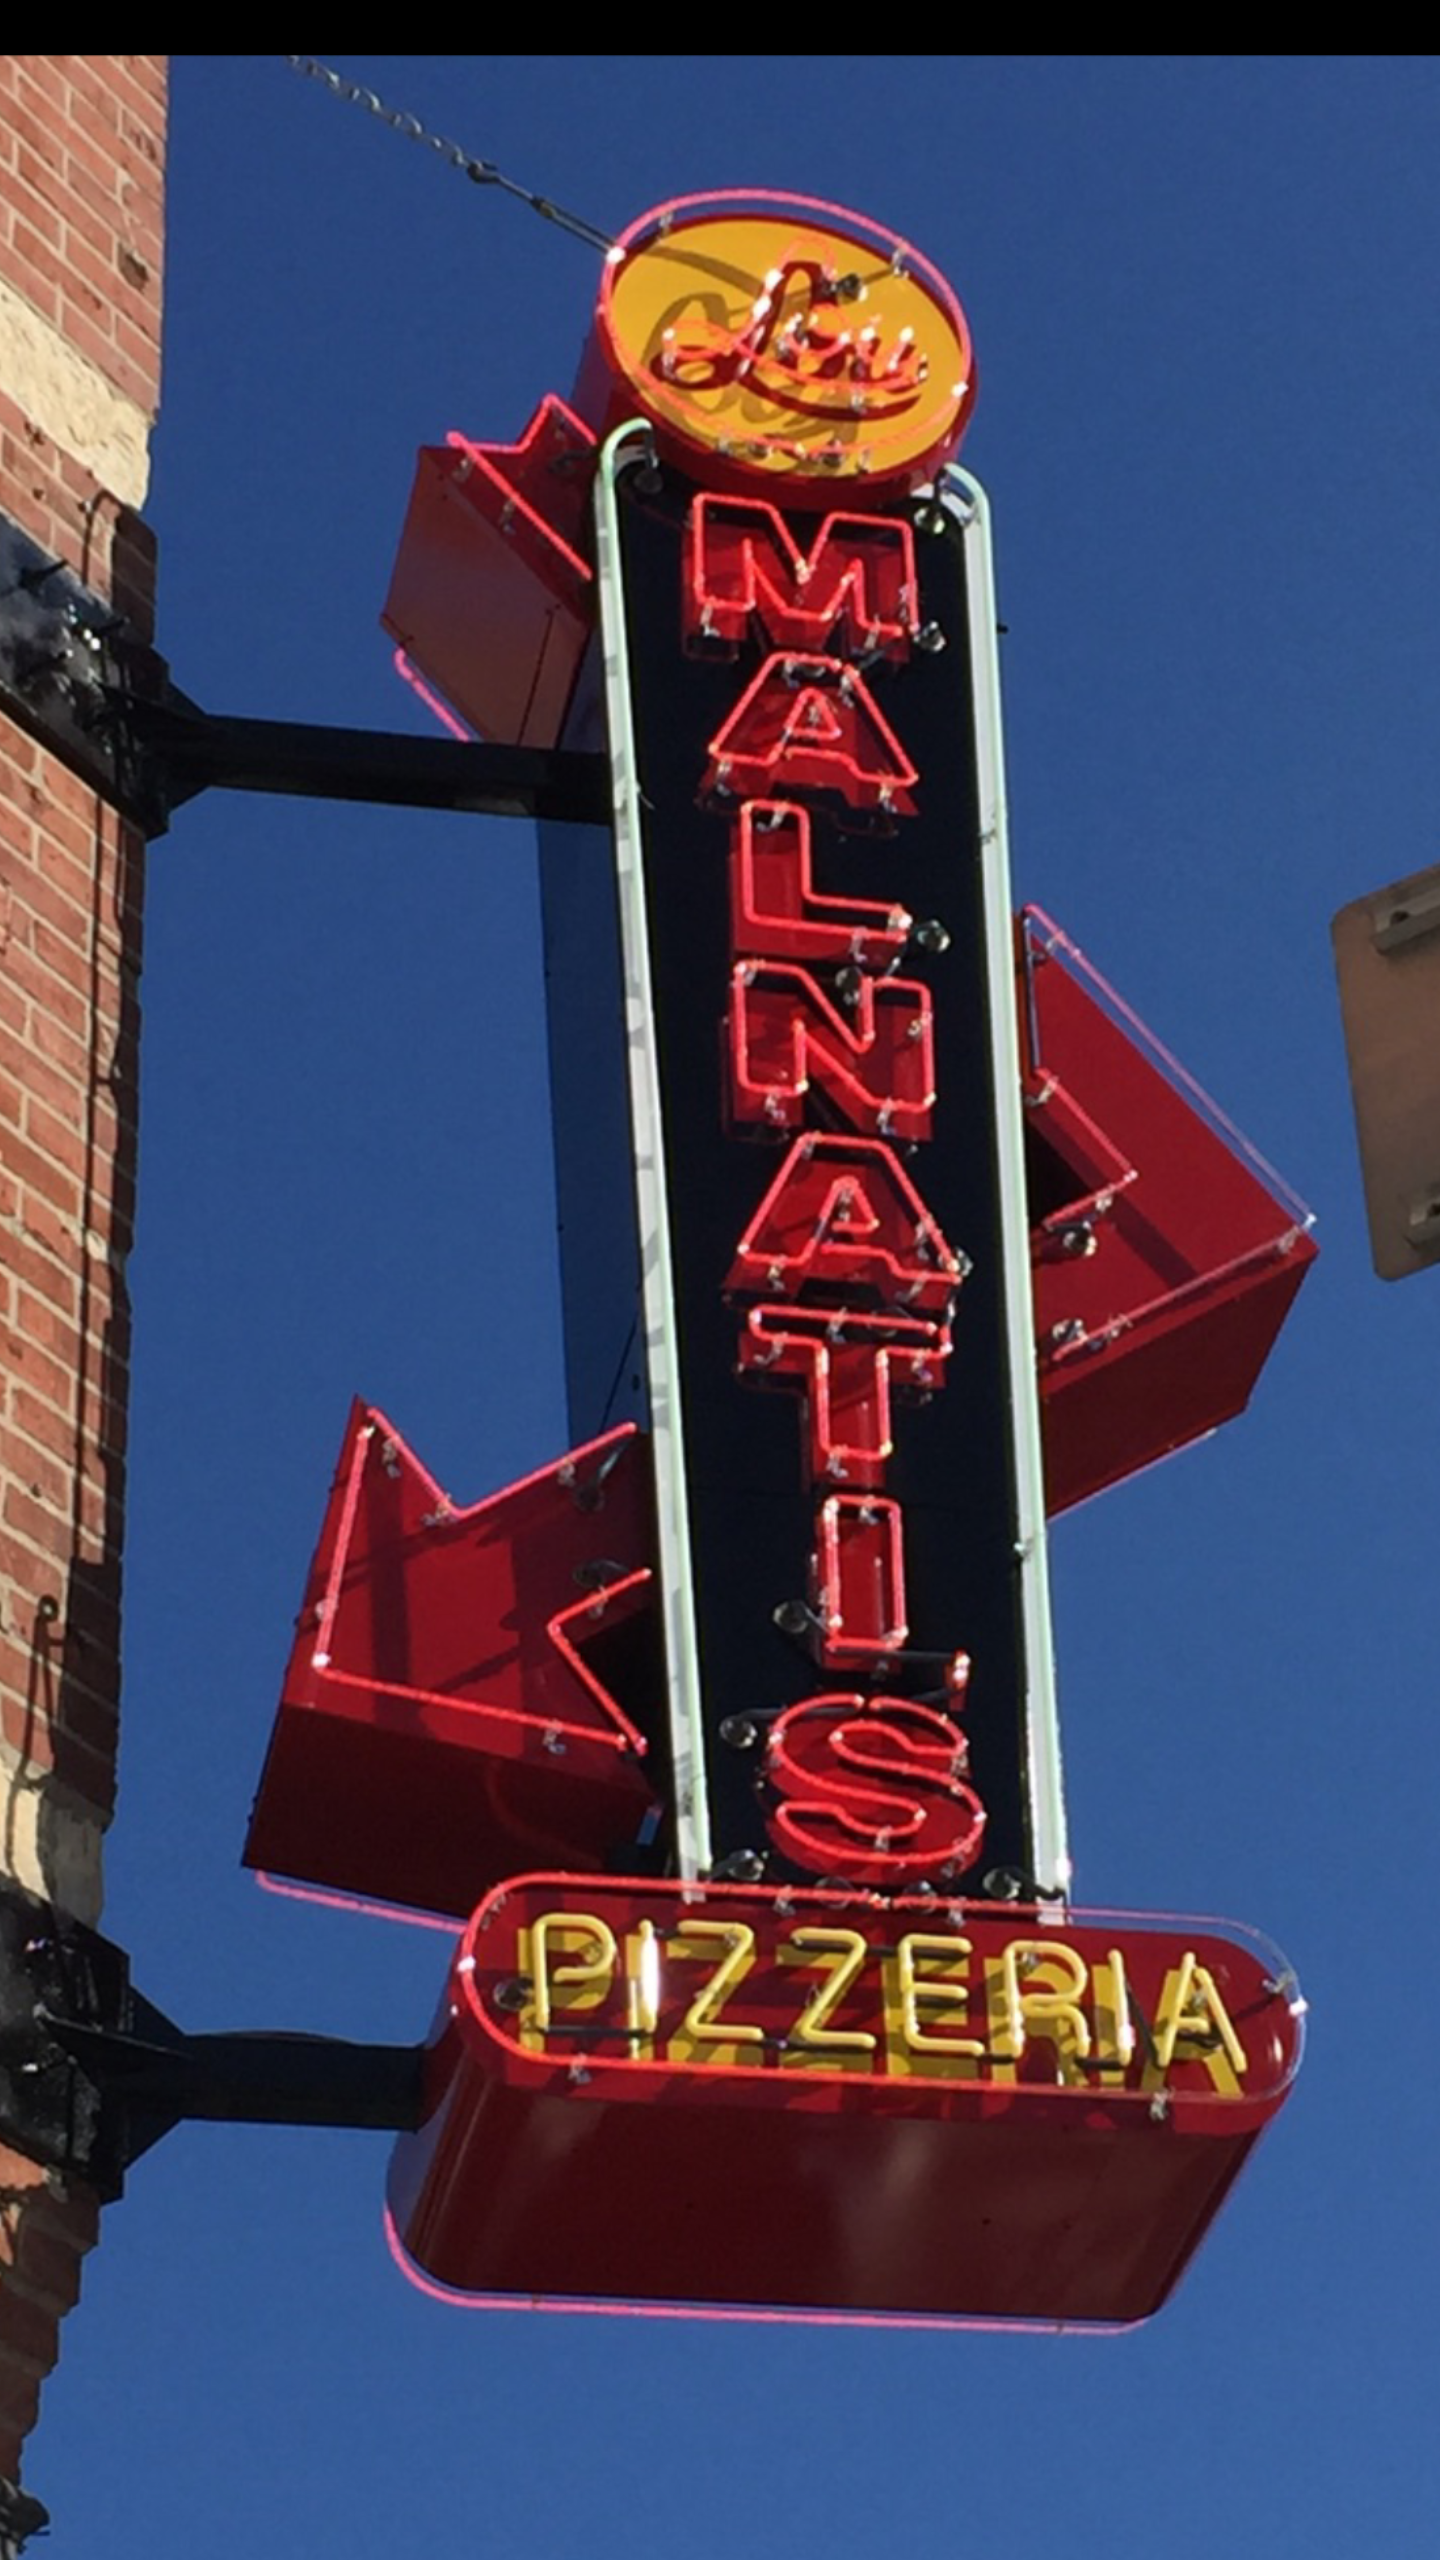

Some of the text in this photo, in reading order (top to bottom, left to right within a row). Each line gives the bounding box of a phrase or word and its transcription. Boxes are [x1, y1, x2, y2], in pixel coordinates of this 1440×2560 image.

[650, 236, 932, 422] Lou
[682, 493, 988, 1886] MALNATI'S
[517, 1911, 1249, 2097] PIZZERIA
